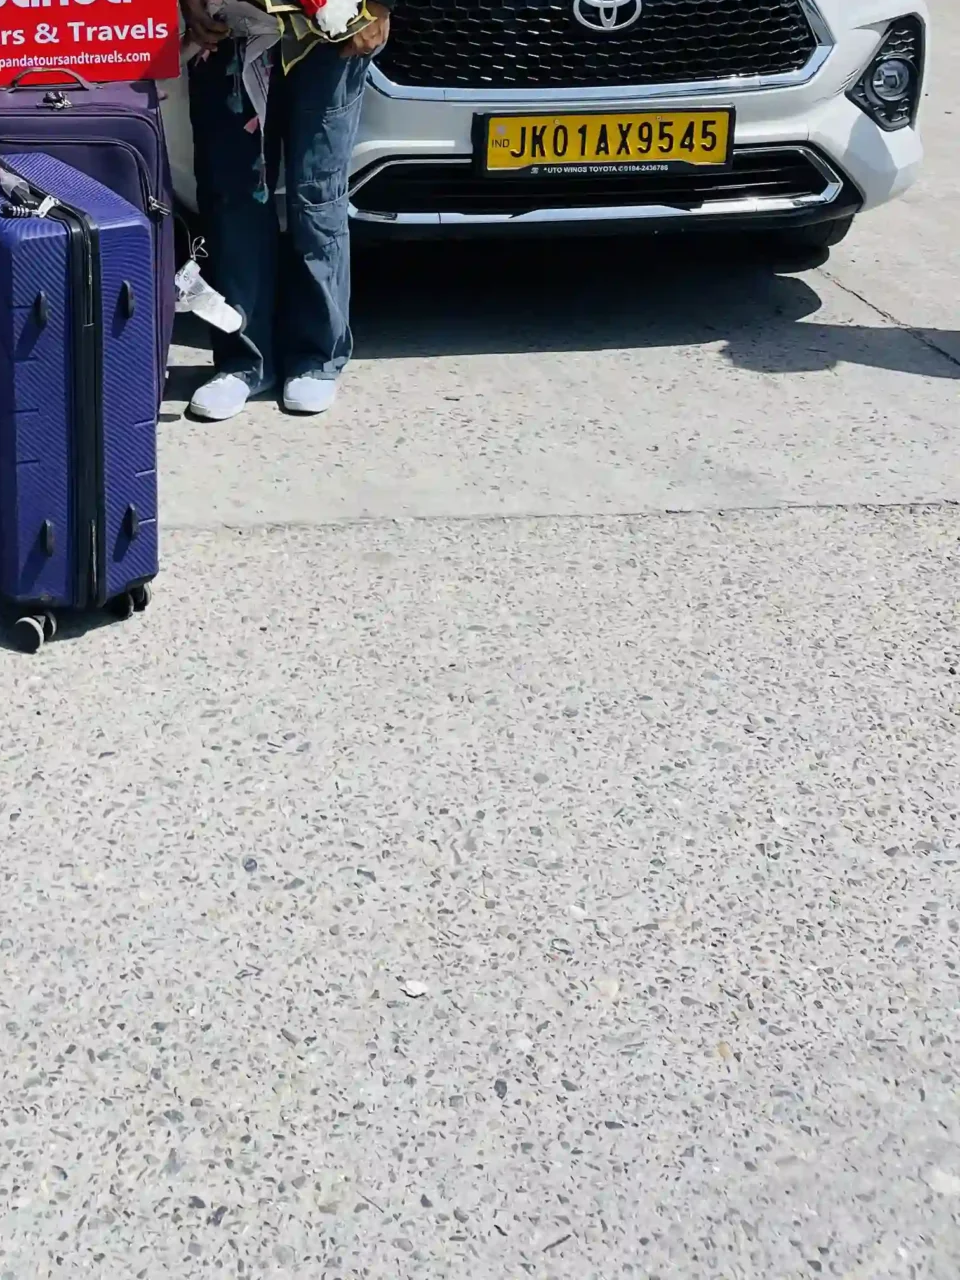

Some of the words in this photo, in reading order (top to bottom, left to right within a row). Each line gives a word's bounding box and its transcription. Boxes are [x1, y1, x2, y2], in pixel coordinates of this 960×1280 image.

[34, 22, 60, 45] &
[67, 17, 169, 42] Travels
[491, 138, 511, 149] IND
[510, 120, 717, 158] JK01AX9545
